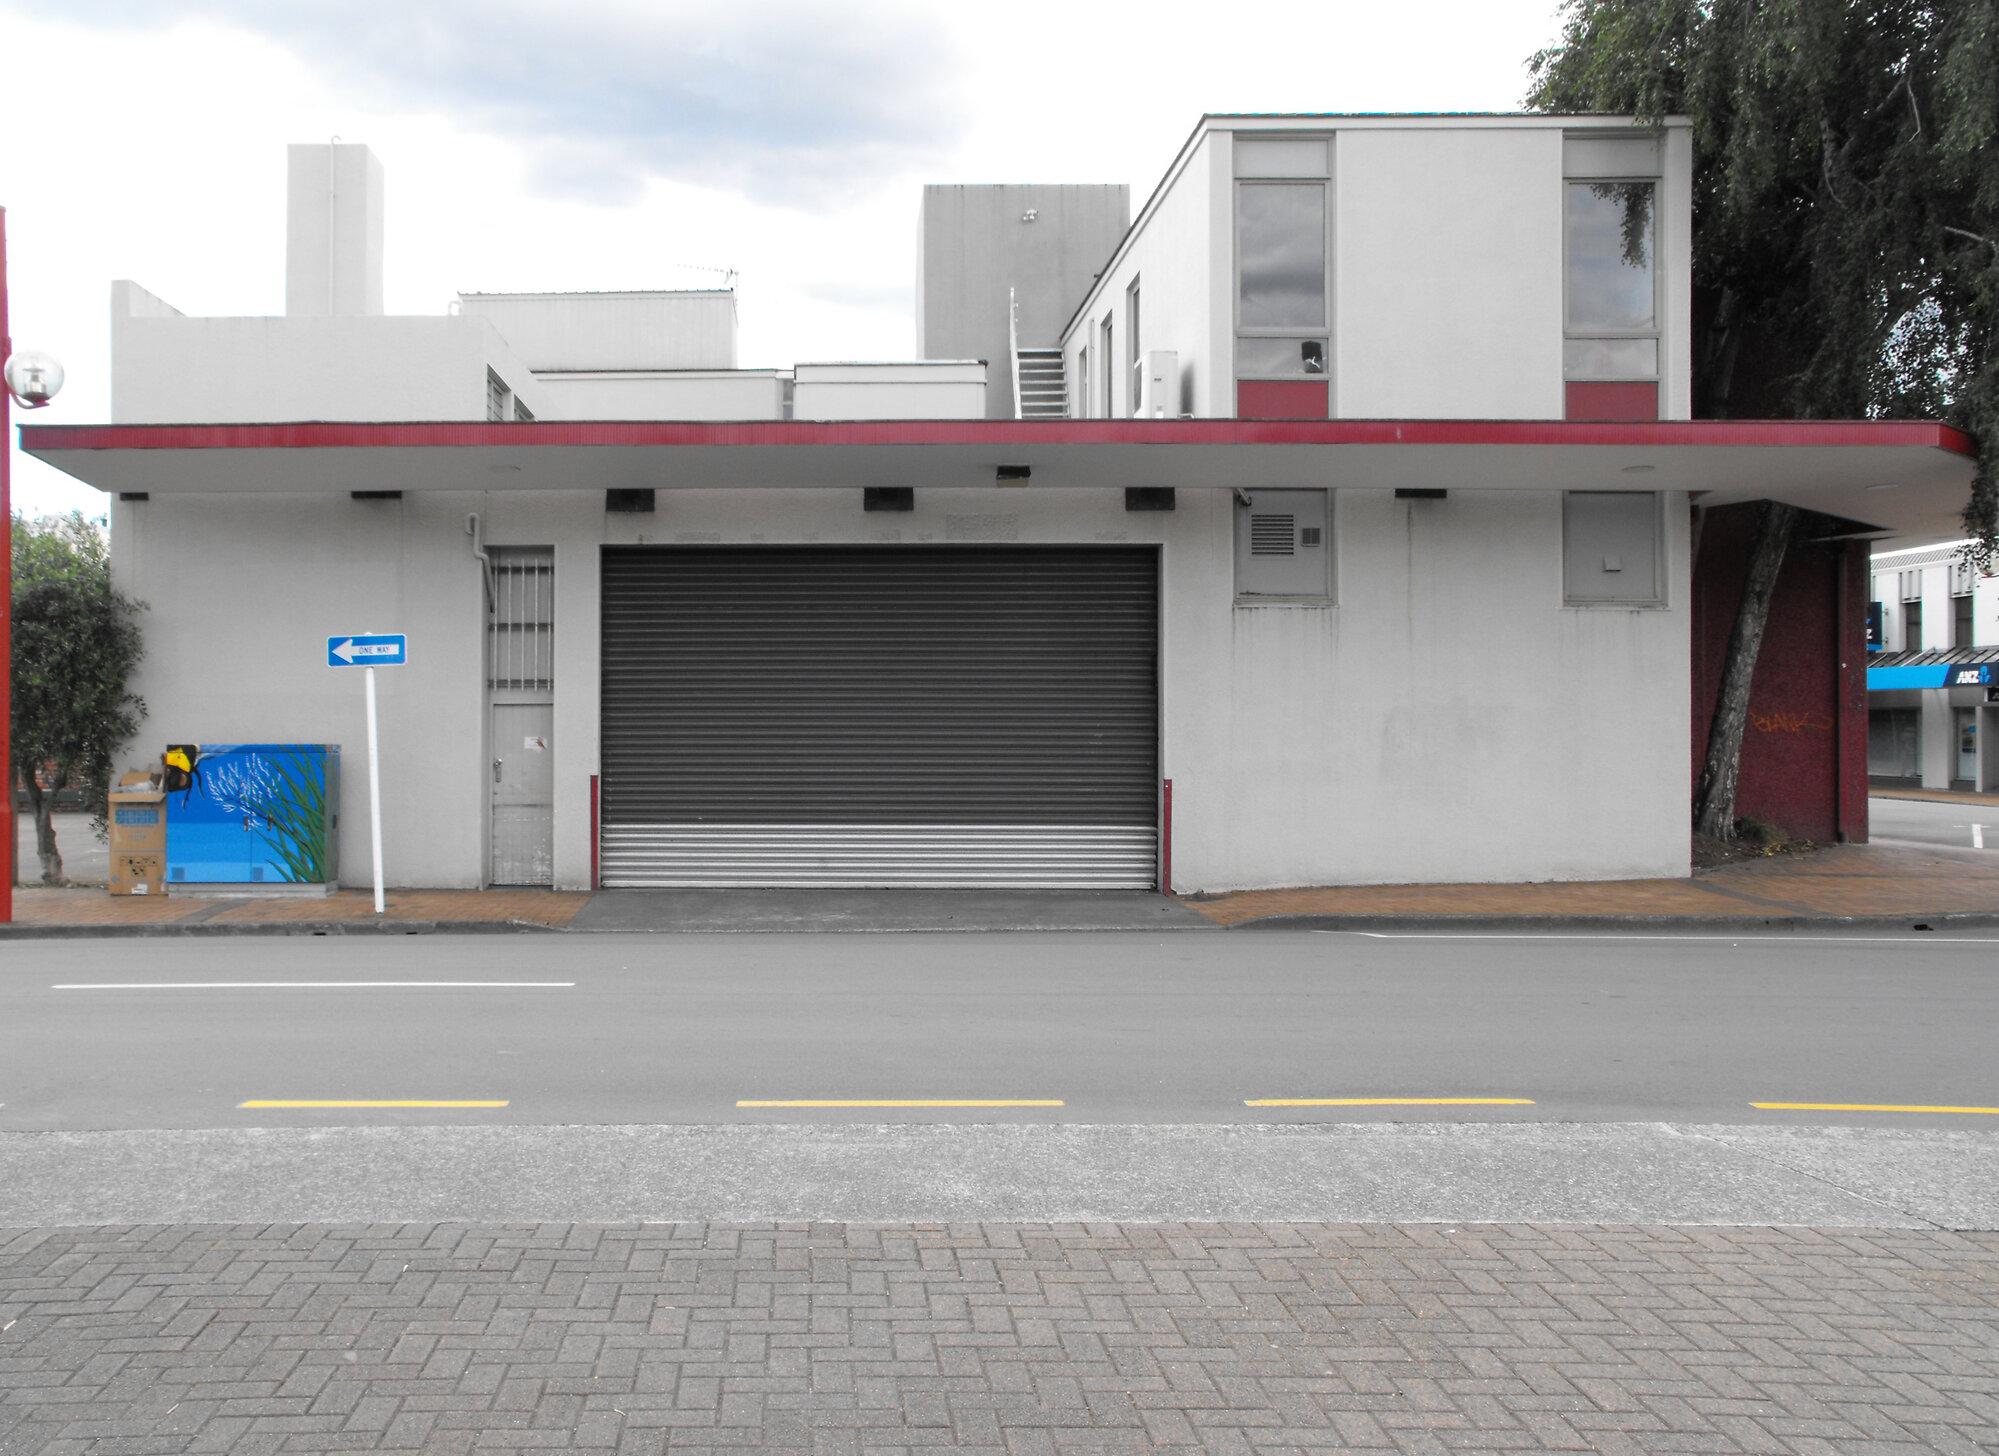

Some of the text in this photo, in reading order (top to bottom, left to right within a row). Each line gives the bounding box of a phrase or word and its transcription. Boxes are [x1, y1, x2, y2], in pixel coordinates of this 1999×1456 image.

[358, 646, 390, 655] ONE WAY
[1956, 670, 1979, 684] ANZ
